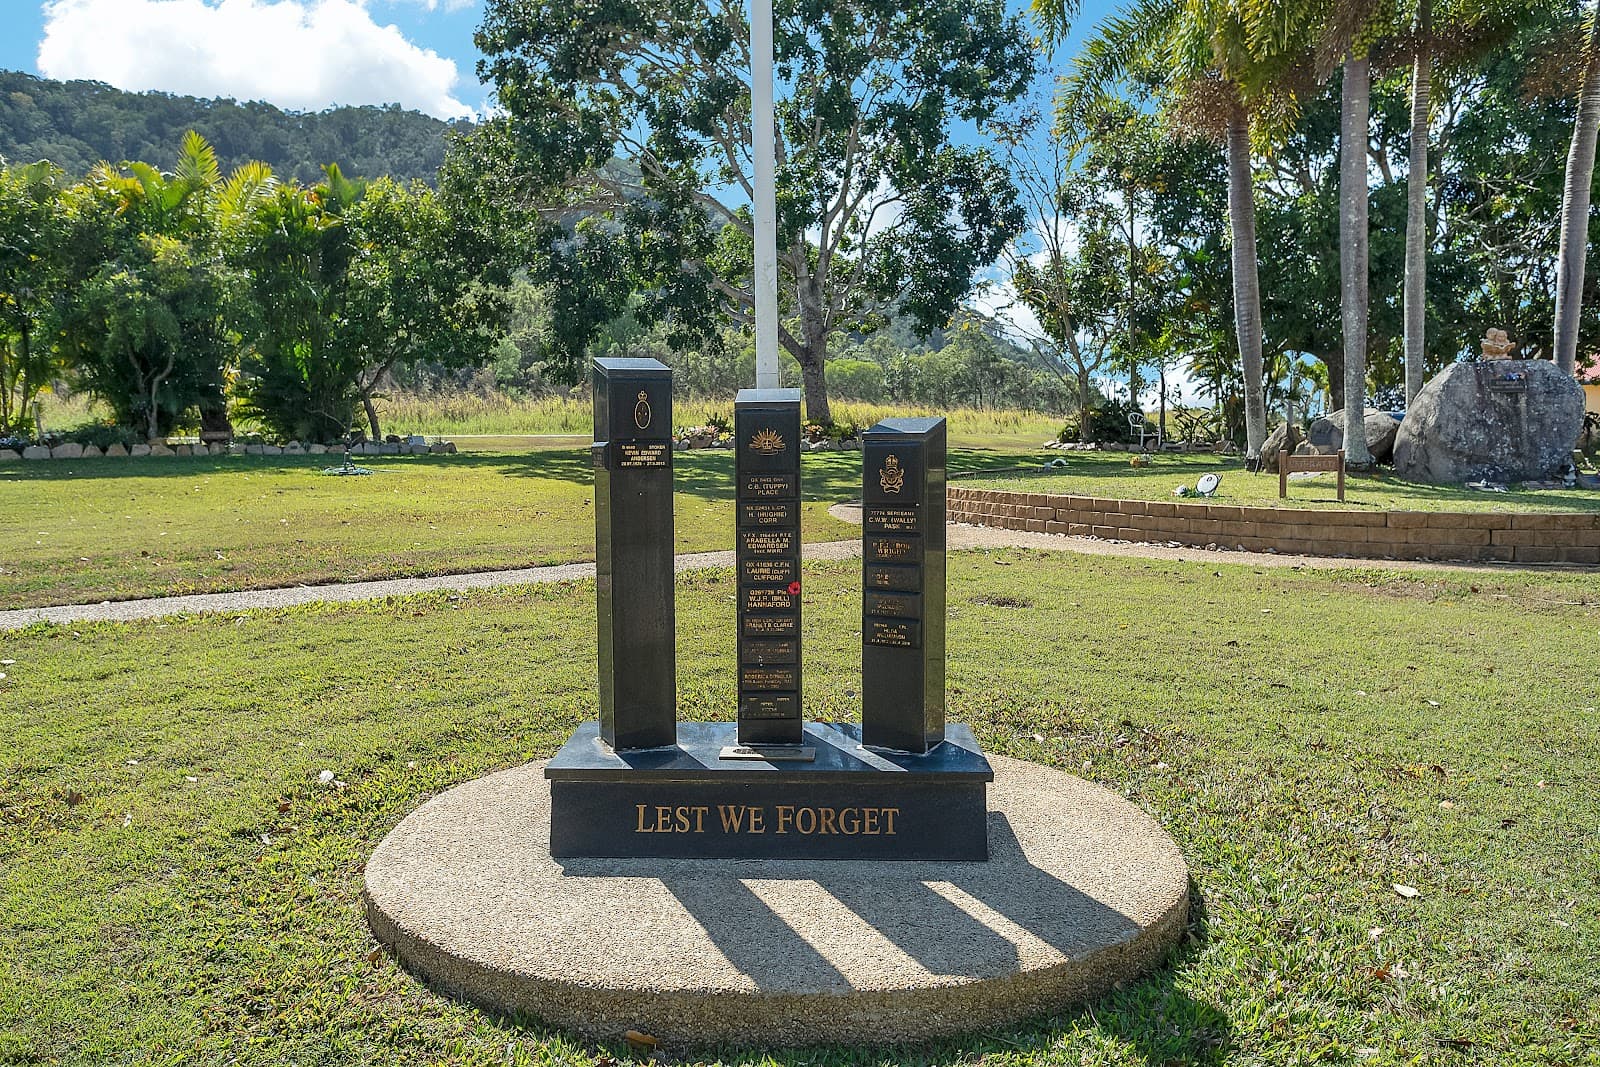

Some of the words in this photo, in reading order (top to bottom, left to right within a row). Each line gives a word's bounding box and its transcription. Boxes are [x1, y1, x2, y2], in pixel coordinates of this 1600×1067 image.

[635, 804, 709, 833] LEST
[717, 805, 766, 834] WE
[775, 805, 900, 835] FORGET
